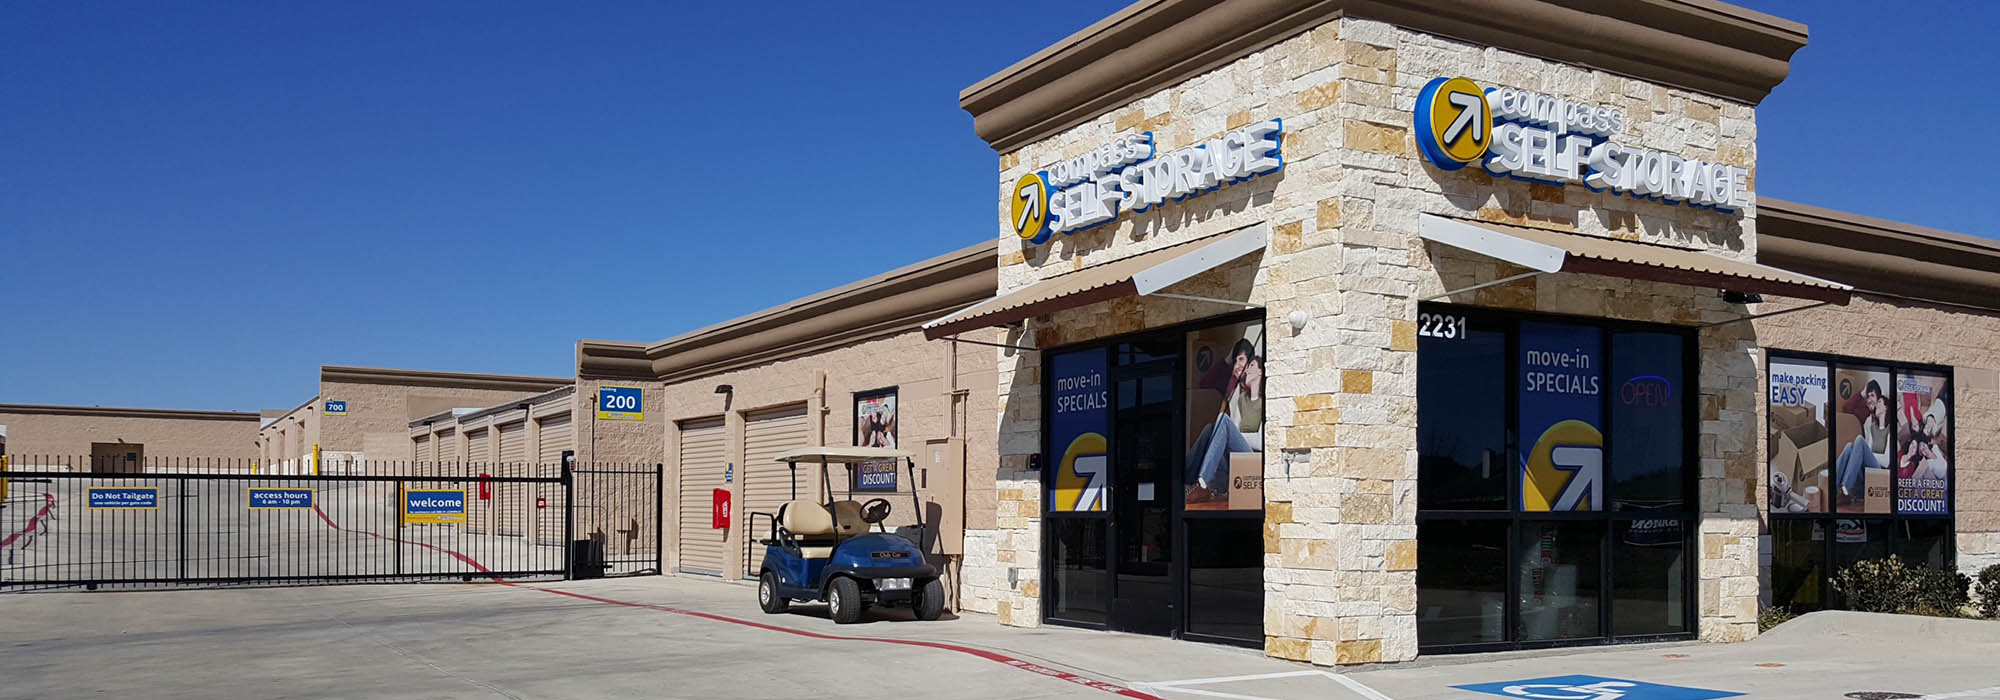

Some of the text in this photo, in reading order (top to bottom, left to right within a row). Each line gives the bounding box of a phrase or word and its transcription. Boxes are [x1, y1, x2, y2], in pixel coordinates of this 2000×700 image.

[1497, 88, 1624, 136] compass
[1048, 133, 1150, 186] compass
[1496, 122, 1749, 208] SELF STORAGE
[1049, 119, 1280, 232] SELF STORAGE
[1419, 313, 1466, 340] 2231
[1527, 348, 1590, 369] move-in
[1057, 369, 1101, 391] move-in
[1527, 371, 1599, 395] SPECIALS
[1771, 371, 1827, 390] make packing
[606, 395, 636, 409] 200
[1057, 391, 1107, 413] SPECIALS
[1620, 382, 1668, 407] OPEN
[1772, 386, 1807, 405] EASY
[863, 473, 896, 485] DISCOUNT!
[1898, 478, 1945, 489] REFER A FRIEND
[122, 493, 154, 501] Tailgate
[284, 491, 308, 499] hours
[410, 497, 462, 507] welcome
[1898, 488, 1912, 498] GET
[1914, 489, 1919, 498] A
[1921, 489, 1945, 499] GREAT
[1898, 499, 1945, 512] DISCOUNT!
